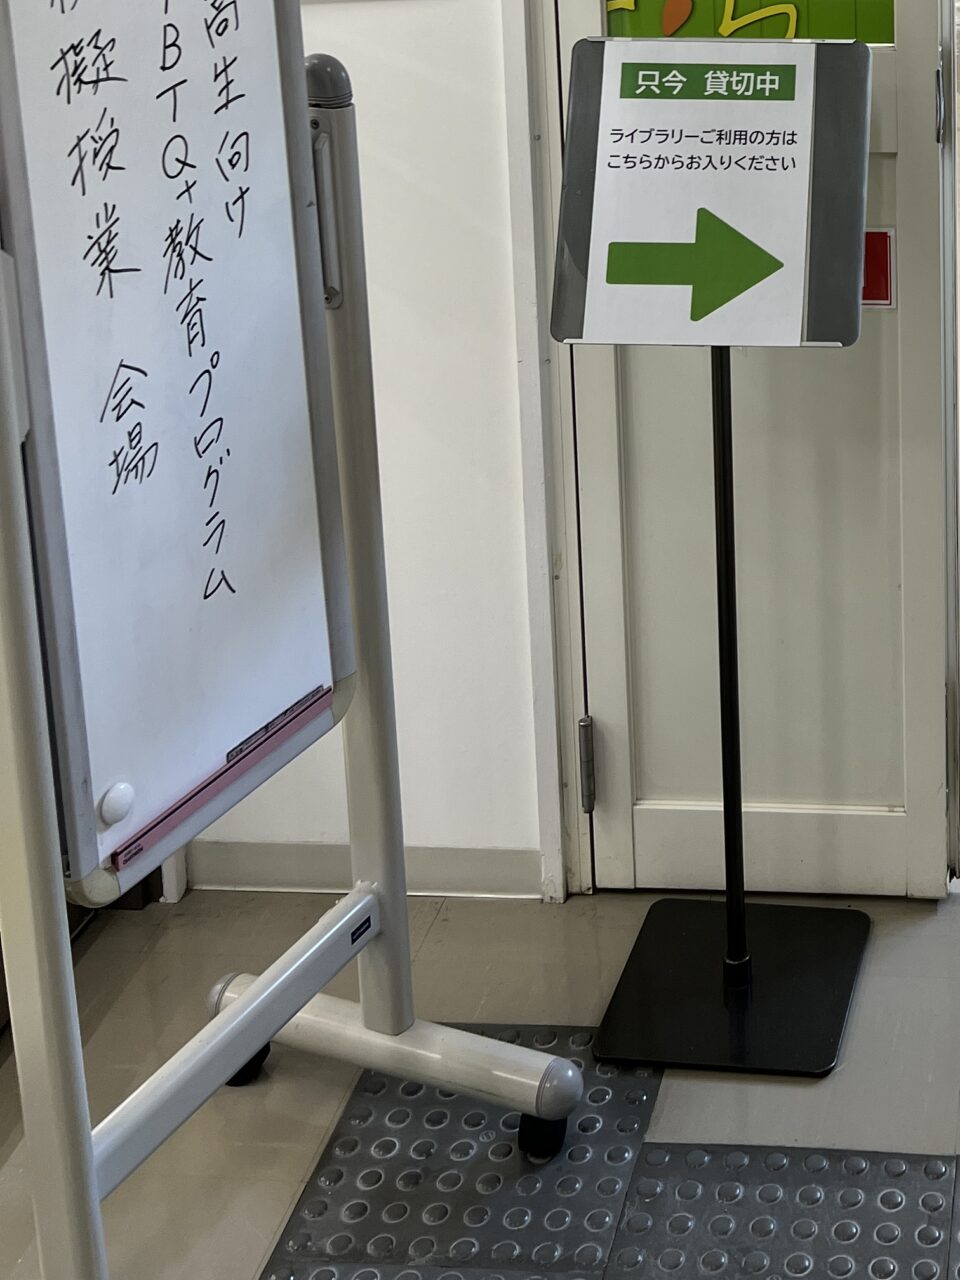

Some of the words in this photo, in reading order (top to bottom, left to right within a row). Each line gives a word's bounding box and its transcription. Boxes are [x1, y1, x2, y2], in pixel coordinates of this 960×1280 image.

[634, 69, 688, 95] 只今
[703, 69, 780, 97] 貸切中
[609, 127, 799, 146] ライブラリーご利用の方は
[606, 153, 797, 172] こちらからお入りください
[100, 358, 159, 496] 会場
